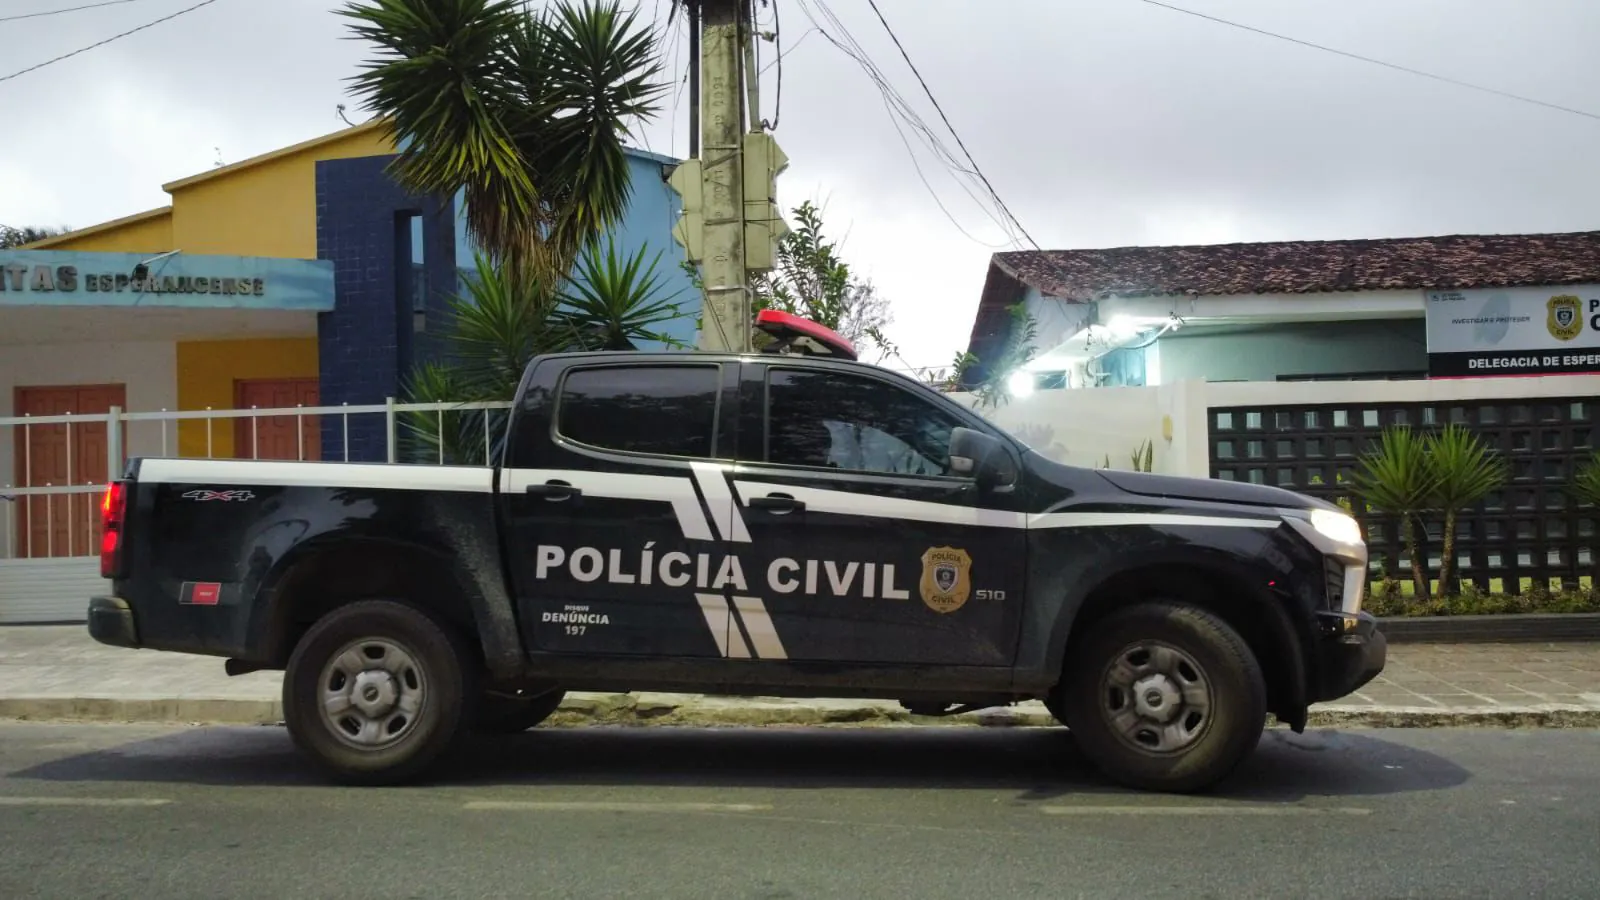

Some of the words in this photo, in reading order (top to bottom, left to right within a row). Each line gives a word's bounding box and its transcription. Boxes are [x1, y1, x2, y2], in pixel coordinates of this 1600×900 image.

[1468, 356, 1539, 369] DELEGACIA
[1543, 356, 1560, 366] DE
[535, 541, 748, 590] POLÍCIA
[767, 557, 910, 600] CIVIL
[931, 595, 956, 604] CIVIL
[564, 604, 590, 612] DISQUE
[542, 611, 610, 625] DENÚNCIA
[565, 625, 586, 636] 197
